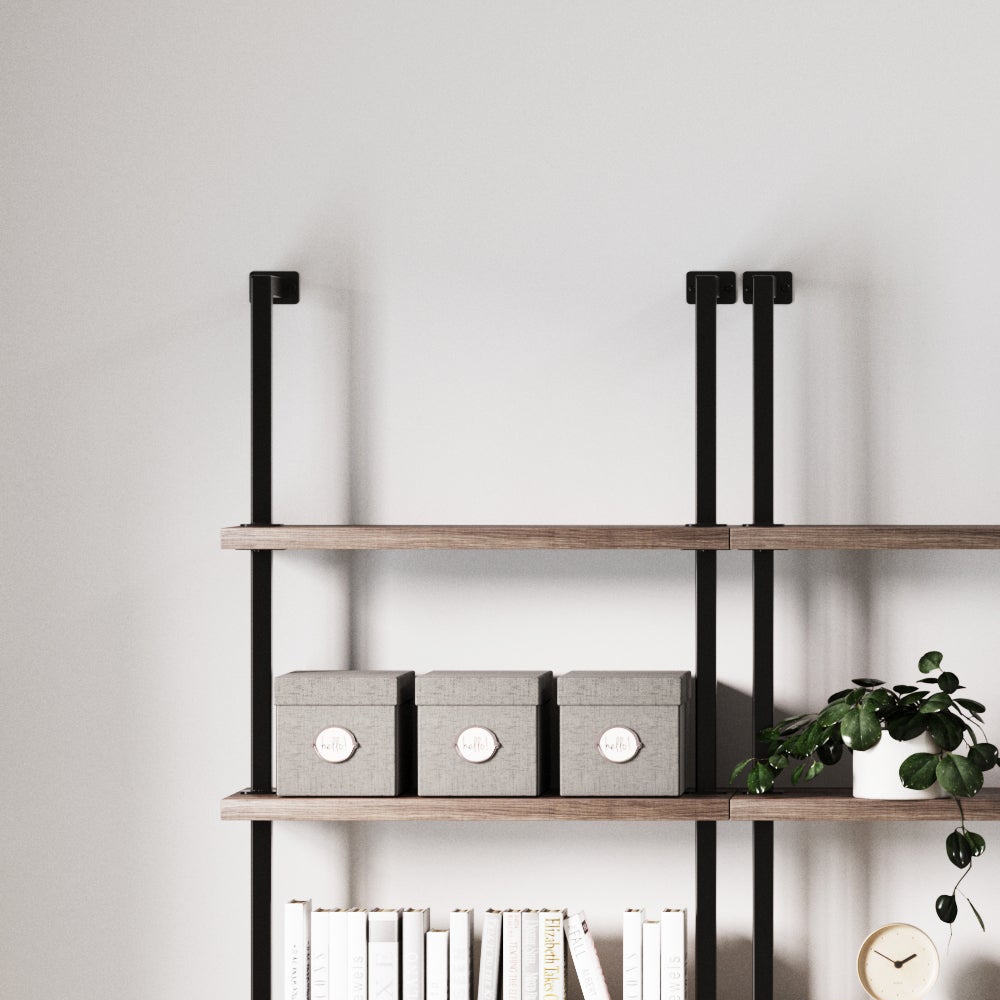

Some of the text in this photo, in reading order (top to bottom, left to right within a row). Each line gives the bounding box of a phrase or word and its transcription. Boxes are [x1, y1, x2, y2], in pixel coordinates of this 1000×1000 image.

[321, 737, 347, 752] hello!
[462, 737, 488, 752] hello!
[604, 737, 630, 752] hello!
[544, 918, 561, 964] Elizabeth
[543, 966, 560, 992] Takes
